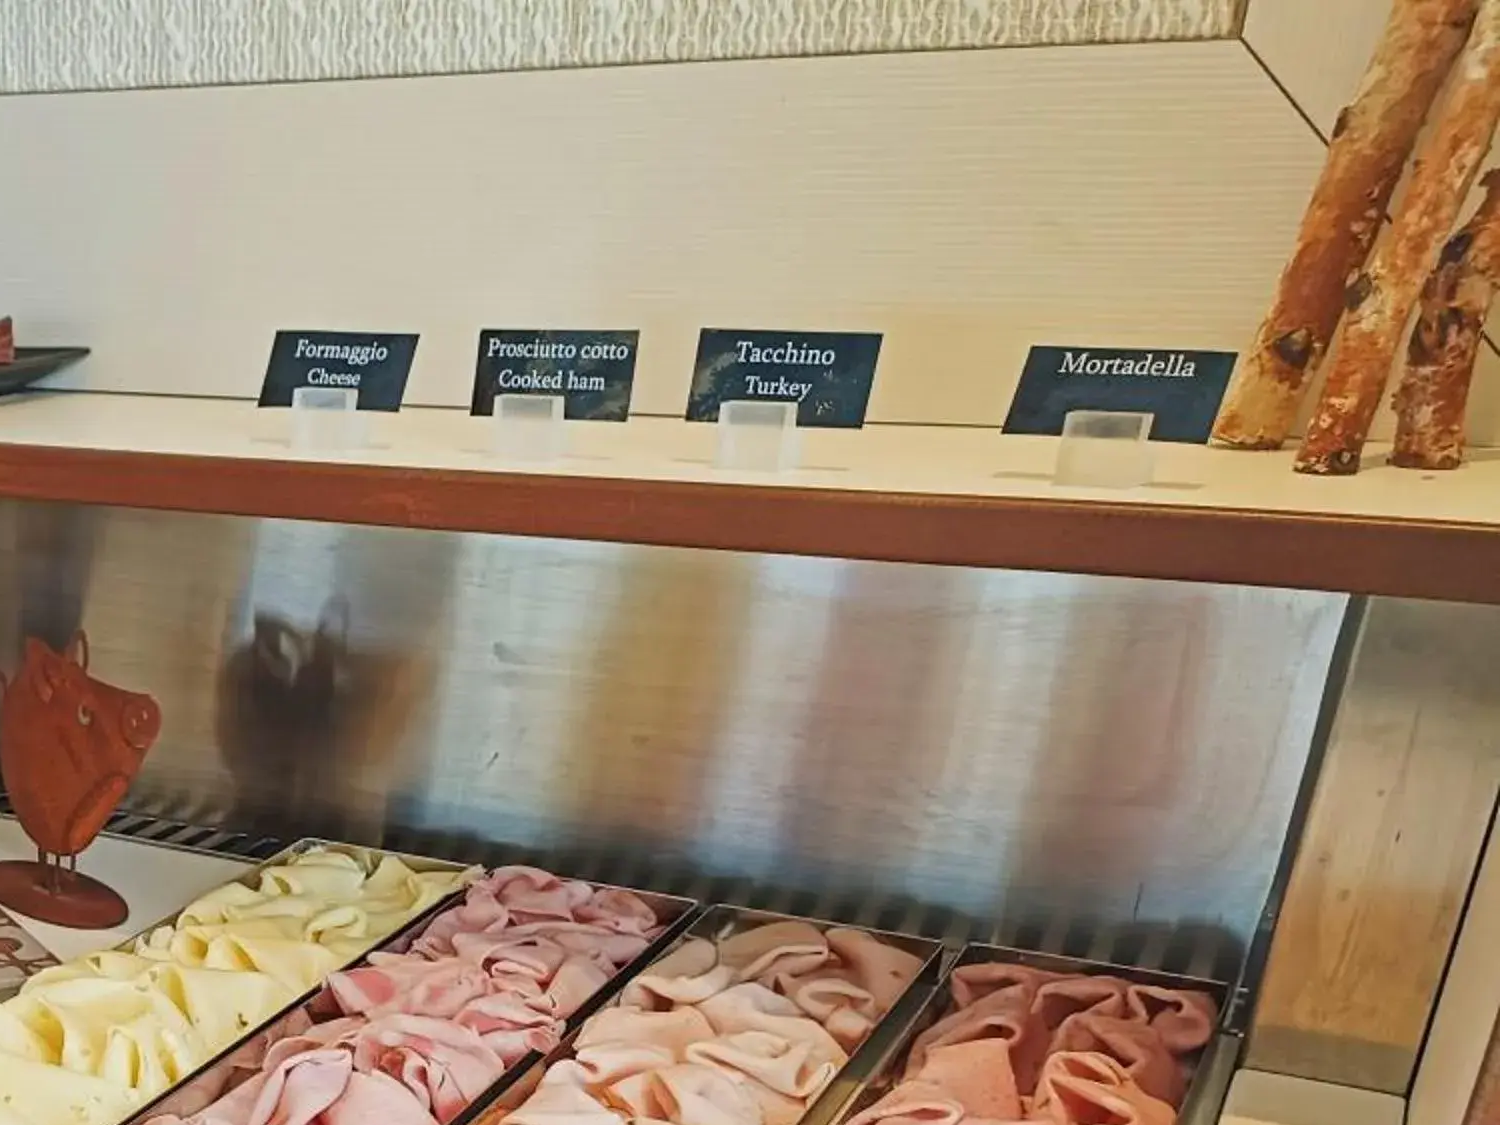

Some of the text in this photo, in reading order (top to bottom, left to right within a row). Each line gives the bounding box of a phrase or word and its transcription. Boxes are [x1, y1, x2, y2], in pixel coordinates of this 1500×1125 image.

[295, 338, 388, 365] Formaggio
[487, 337, 629, 360] Prosciutto cotto
[736, 340, 836, 366] Tacchino
[307, 367, 361, 386] Cheese
[1057, 351, 1197, 377] Mortadella
[499, 368, 605, 391] Cooked ham
[745, 375, 813, 402] Turkey
